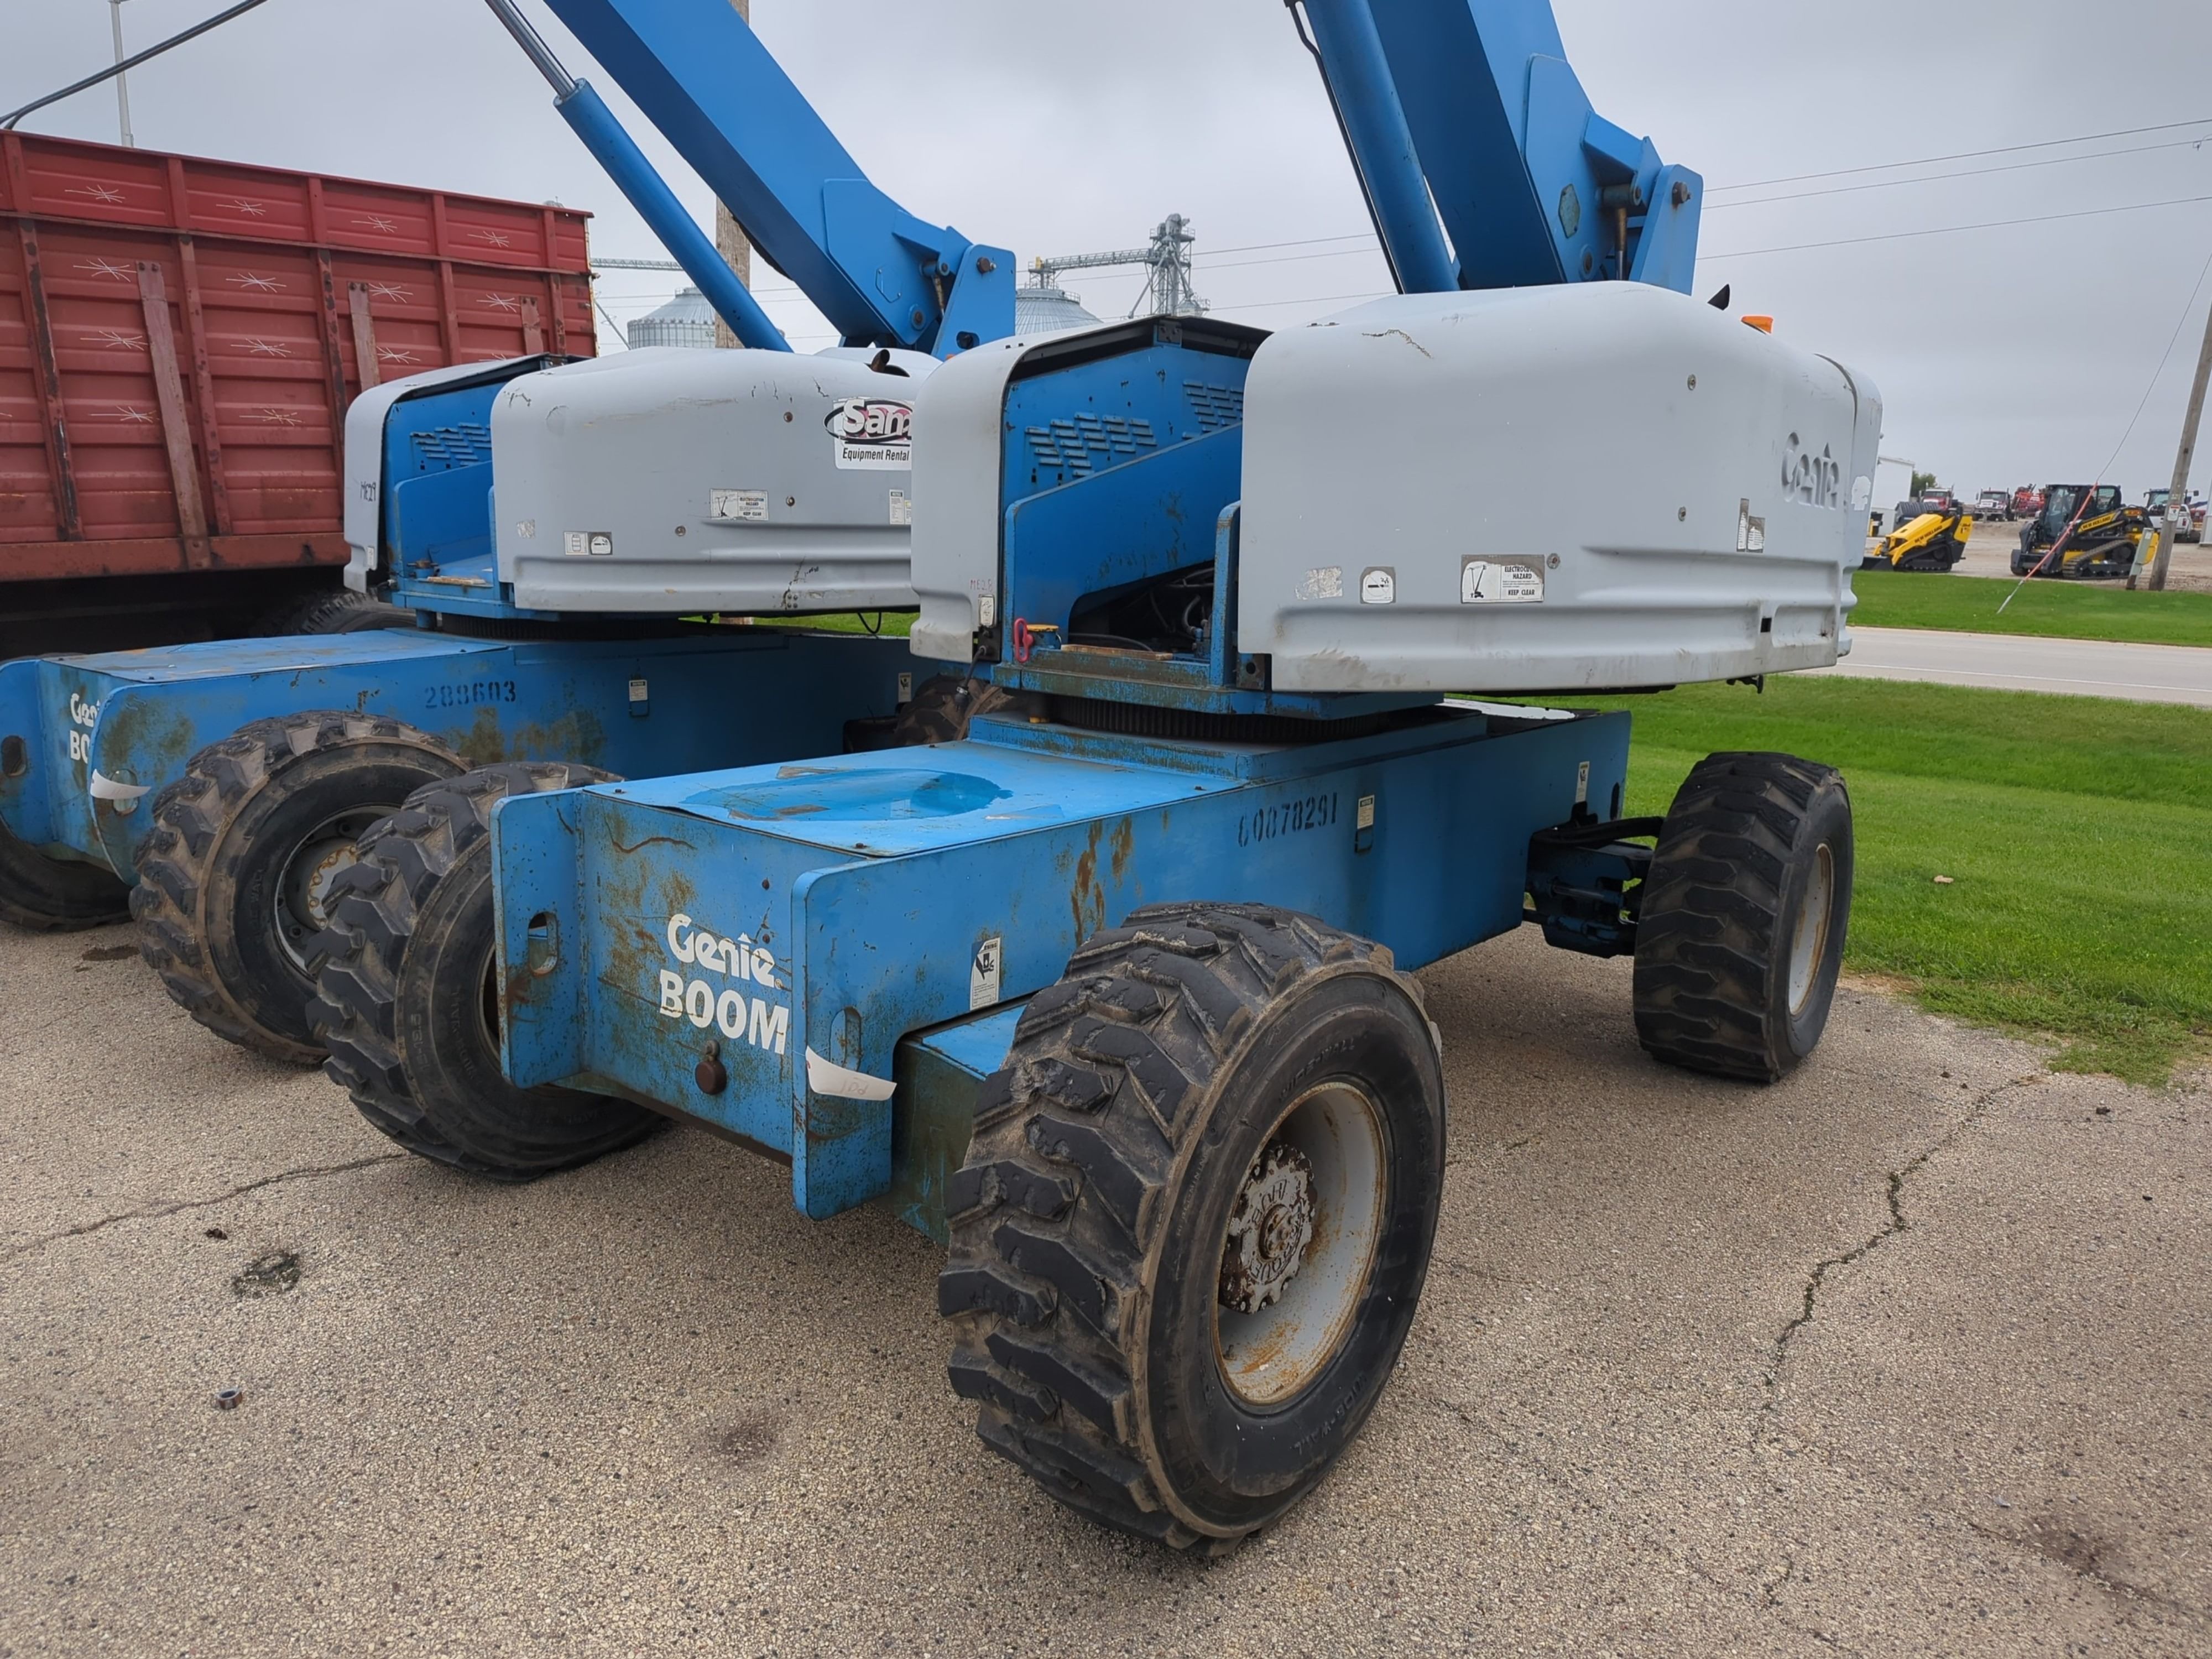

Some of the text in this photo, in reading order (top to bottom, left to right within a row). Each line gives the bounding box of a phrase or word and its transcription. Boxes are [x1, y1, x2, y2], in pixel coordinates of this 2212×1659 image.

[842, 447, 910, 462] Equipment Rental
[1781, 432, 1840, 510] Genie
[667, 914, 775, 988] Genie
[659, 969, 789, 1055] BOOM
[1251, 1178, 1288, 1226] HUB
